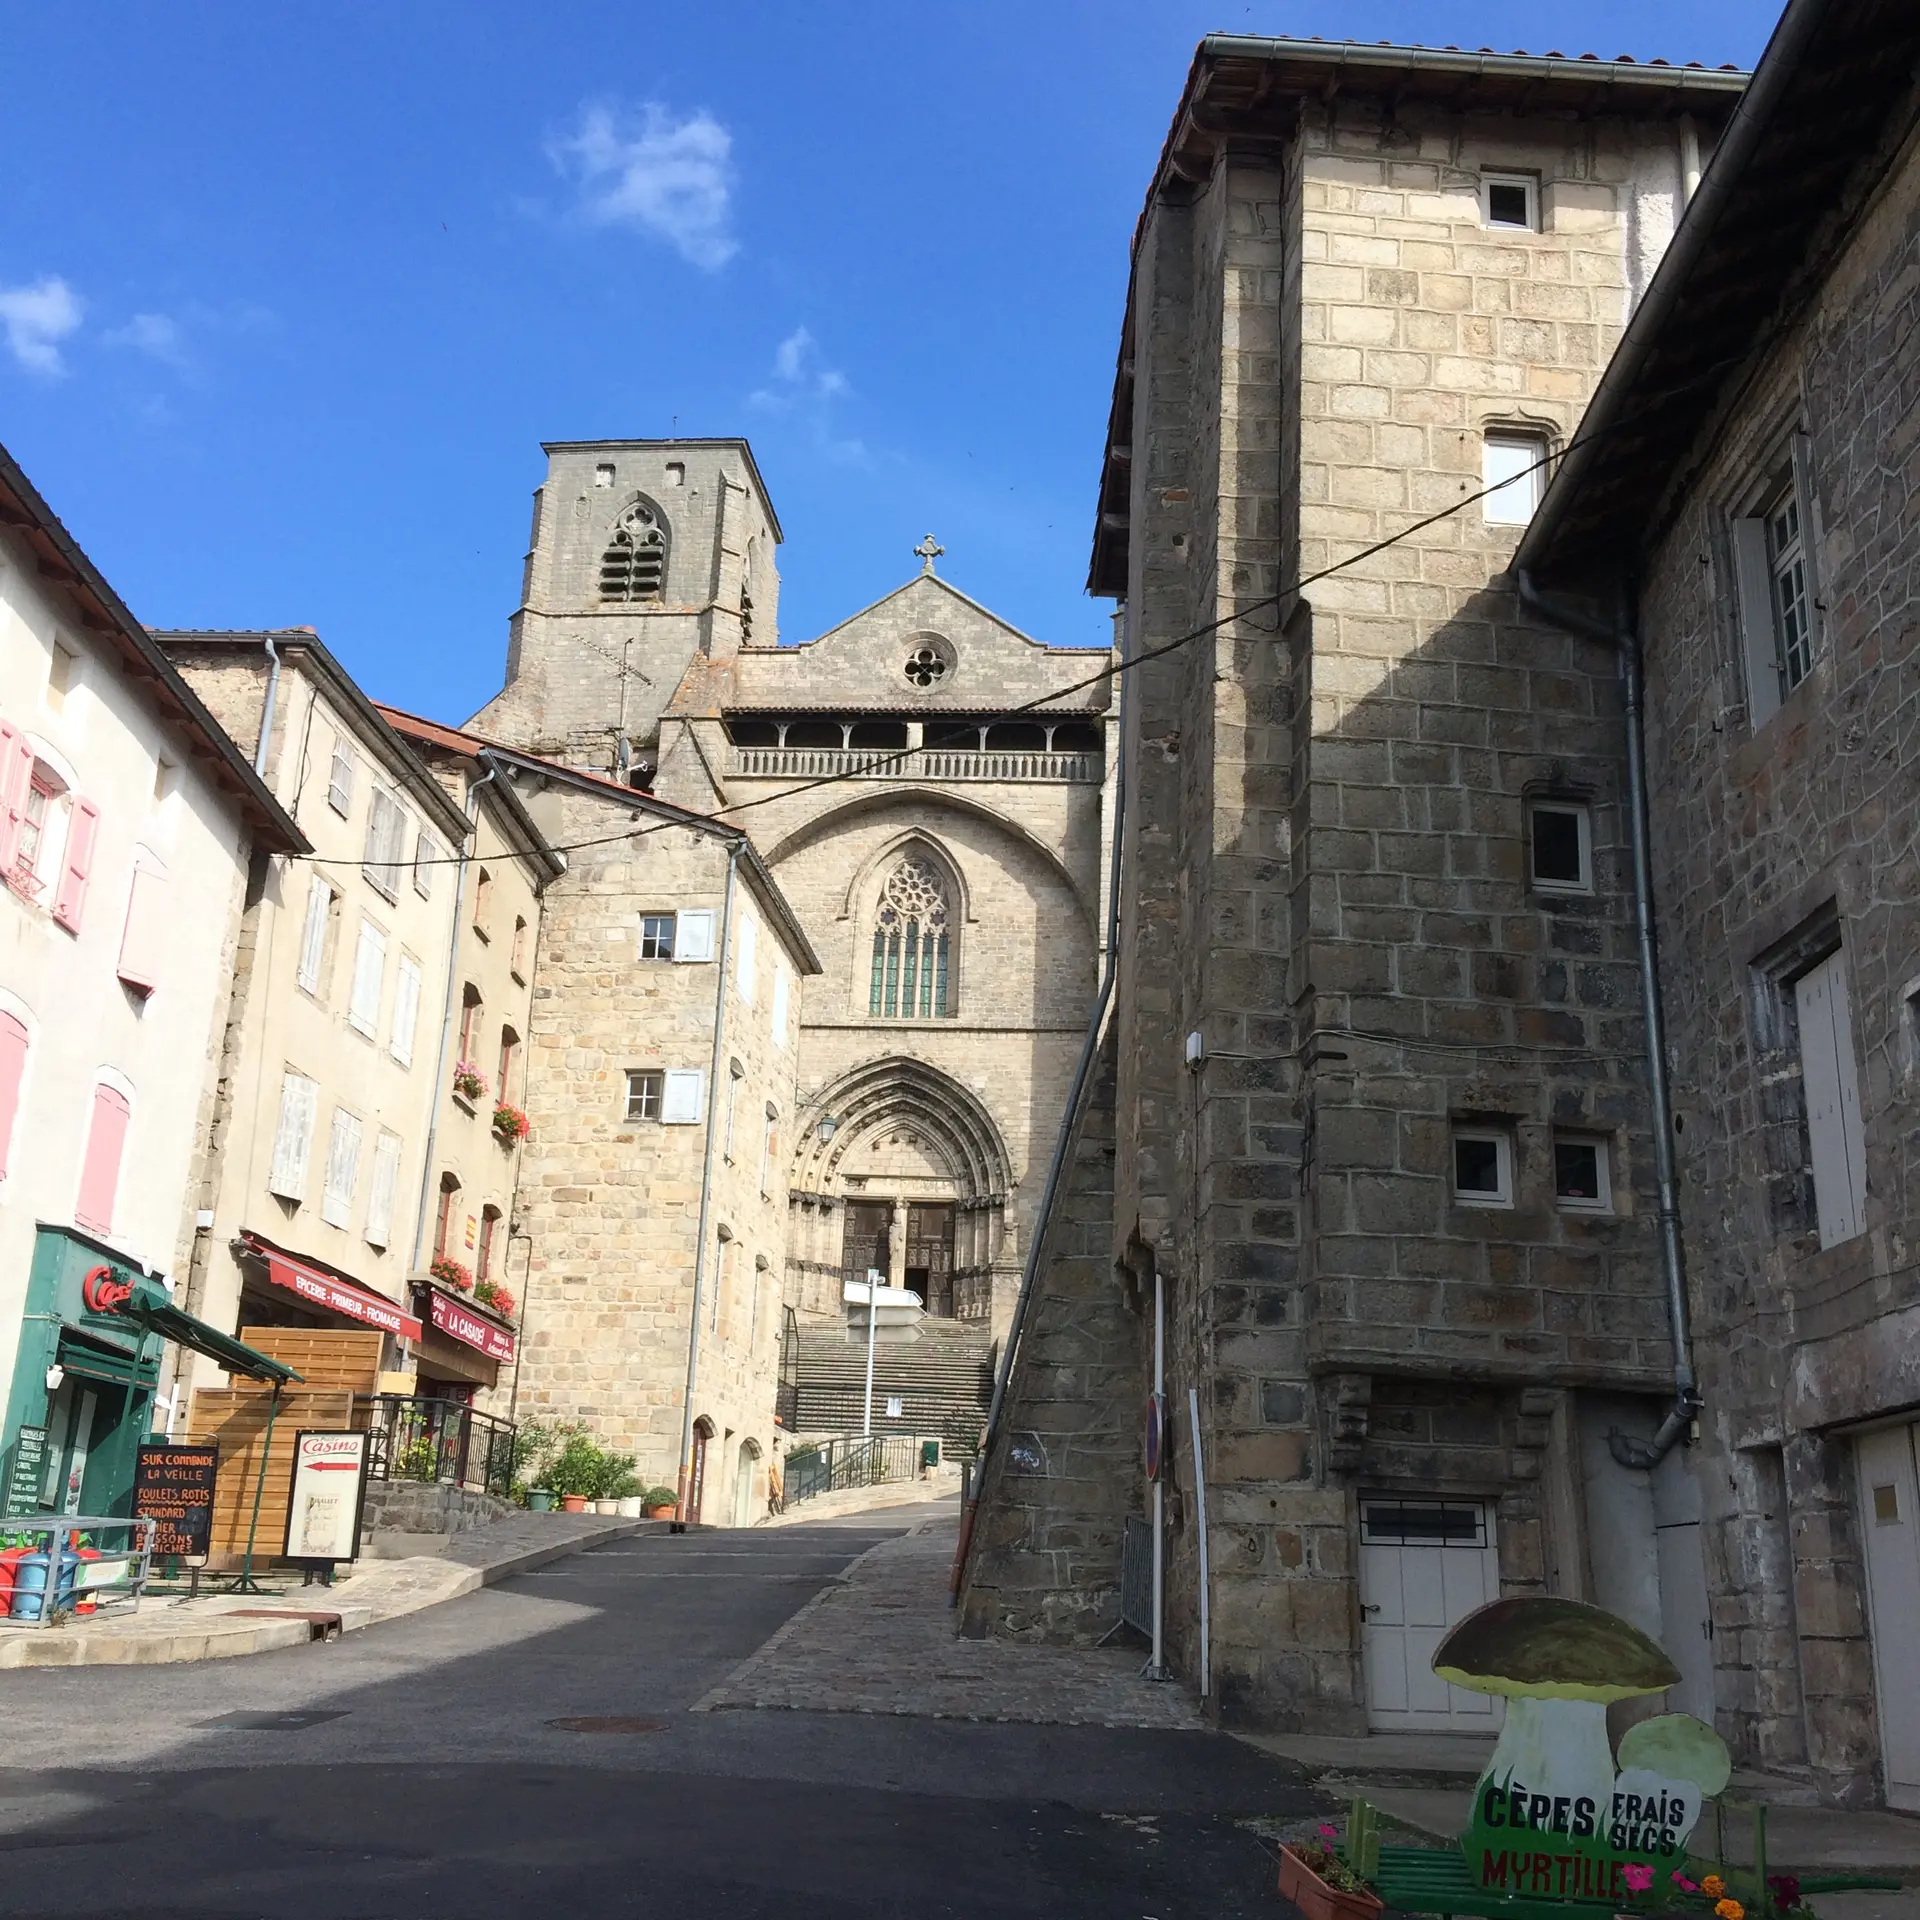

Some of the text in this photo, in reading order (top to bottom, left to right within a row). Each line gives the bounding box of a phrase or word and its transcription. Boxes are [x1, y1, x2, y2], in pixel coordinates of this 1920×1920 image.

[295, 1275, 327, 1301] EPICERIE
[331, 1291, 363, 1315] PRIMEUR
[366, 1306, 401, 1330] FROMAGE
[448, 1312, 458, 1332] LA
[302, 1438, 359, 1455] Casino
[141, 1454, 214, 1467] SUR COMMANDE
[147, 1467, 203, 1480] LA VEILLE
[138, 1486, 210, 1500] POULETS ROTIS
[136, 1507, 186, 1518] STANDARD
[135, 1520, 176, 1534] FEIER
[136, 1533, 193, 1546] BSSONS
[135, 1542, 193, 1554] FAICHES
[1483, 1781, 1596, 1837] CÈPES
[1611, 1789, 1685, 1827] FRAIS
[1611, 1823, 1676, 1858] SECS
